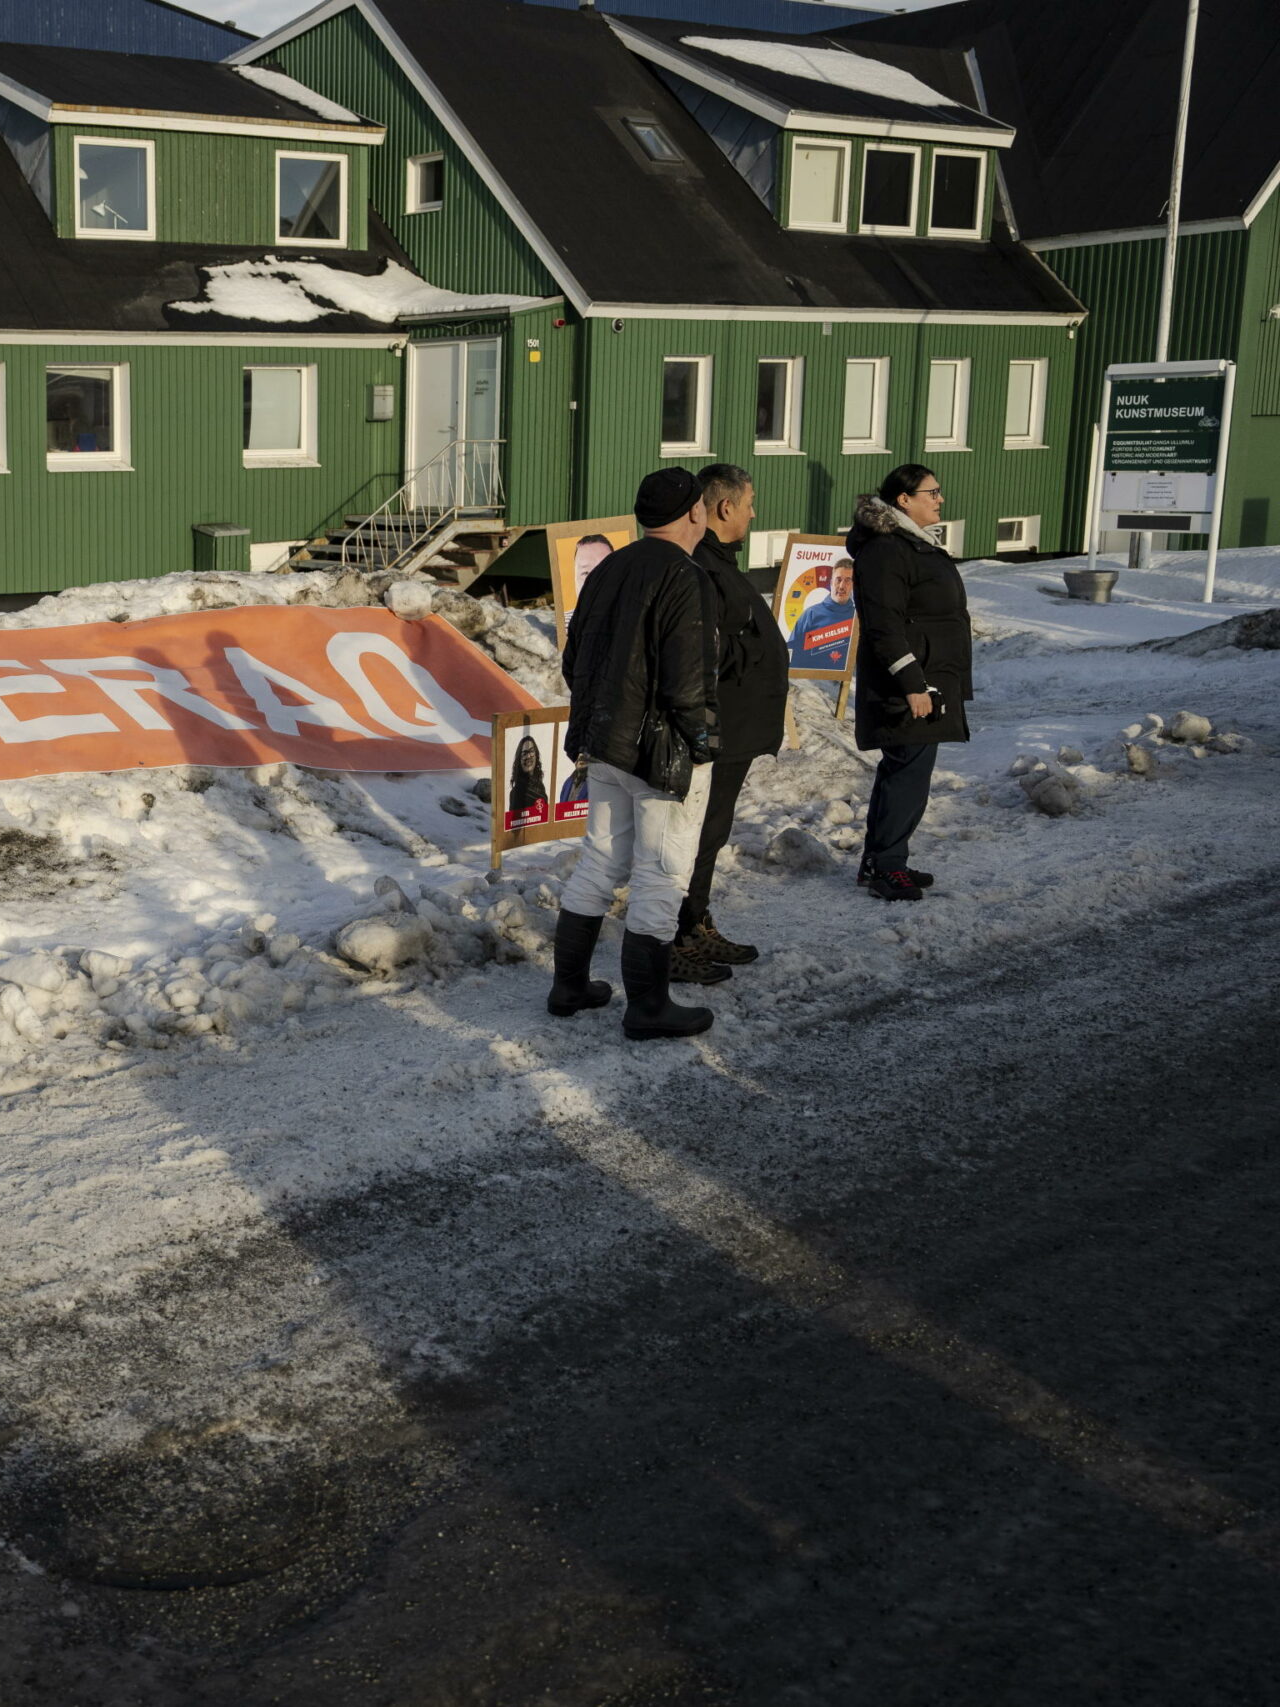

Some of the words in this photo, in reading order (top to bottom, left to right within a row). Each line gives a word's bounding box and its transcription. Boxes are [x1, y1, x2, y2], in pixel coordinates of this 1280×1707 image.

[1116, 395, 1149, 406] NUUK
[1115, 406, 1205, 419] KUNSTMUSEUM
[796, 550, 833, 562] SIUMUT
